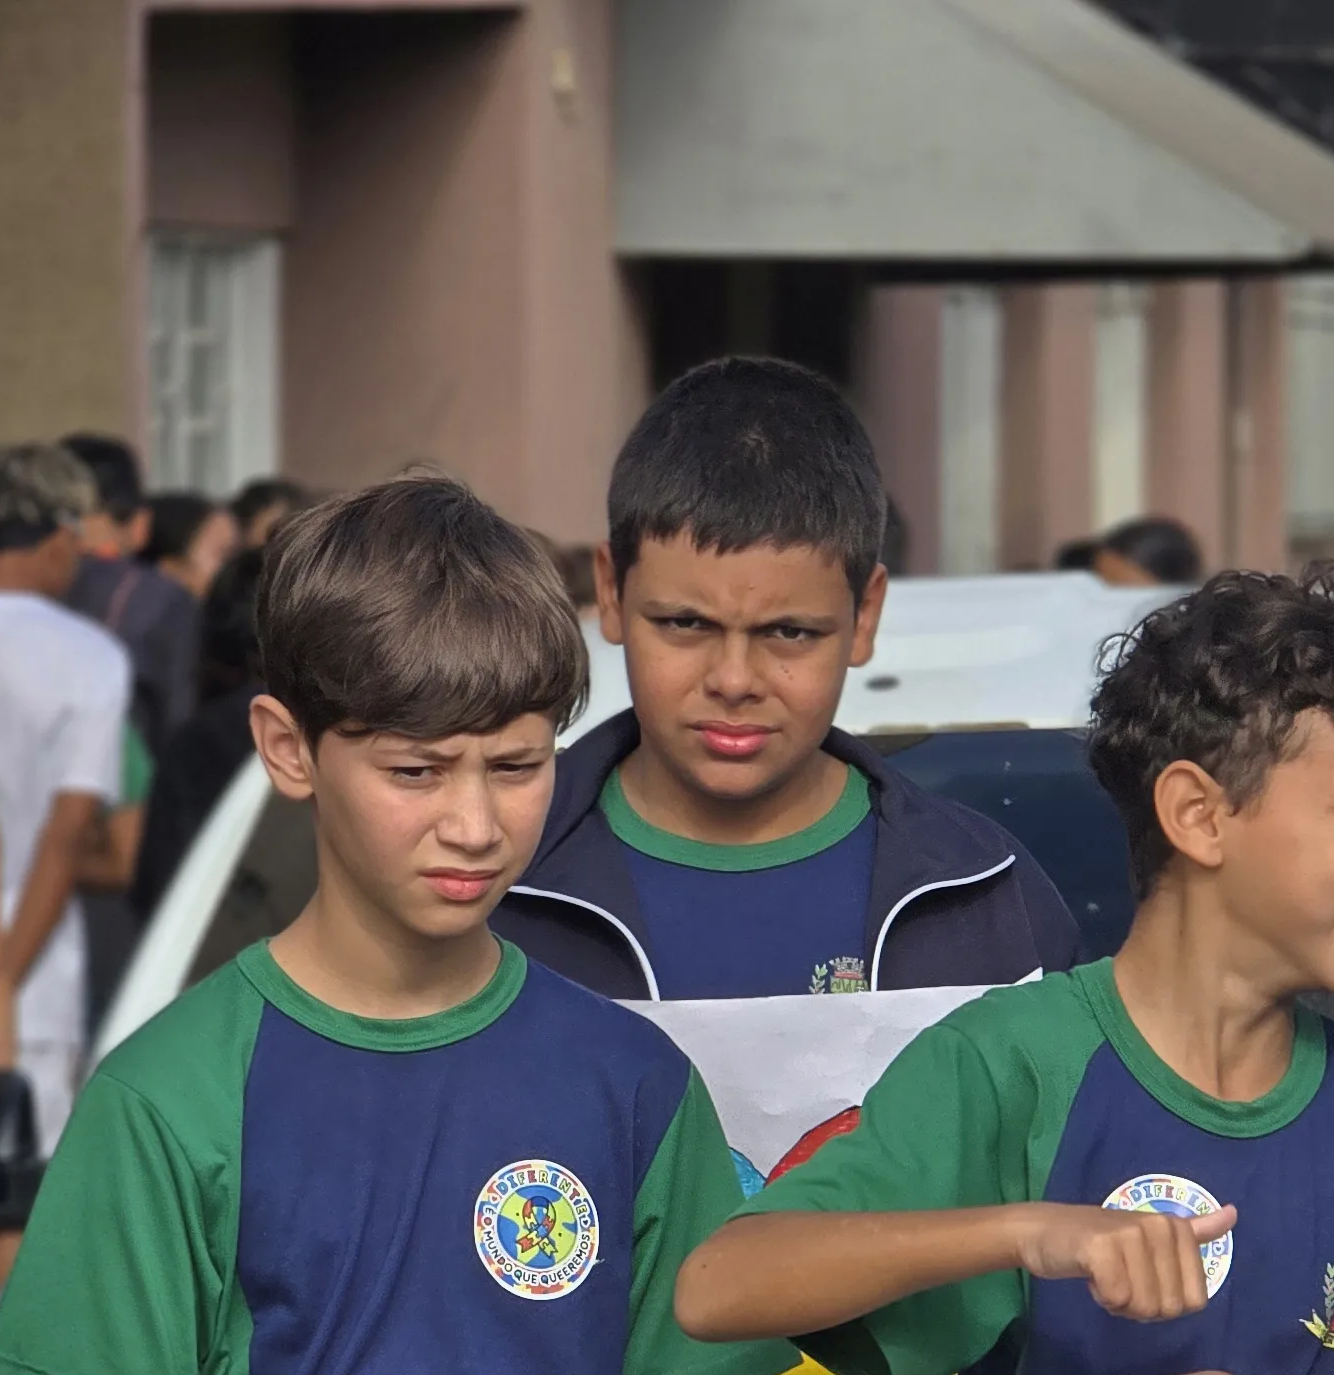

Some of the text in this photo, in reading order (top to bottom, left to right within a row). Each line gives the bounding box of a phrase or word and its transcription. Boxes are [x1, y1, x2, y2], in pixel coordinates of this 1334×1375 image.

[495, 1169, 588, 1215] DIFERENTE
[1129, 1184, 1211, 1215] DIFEREN
[483, 1230, 513, 1273] MUNDO
[514, 1268, 538, 1285] QUE
[540, 1233, 591, 1286] QUEEREMOS
